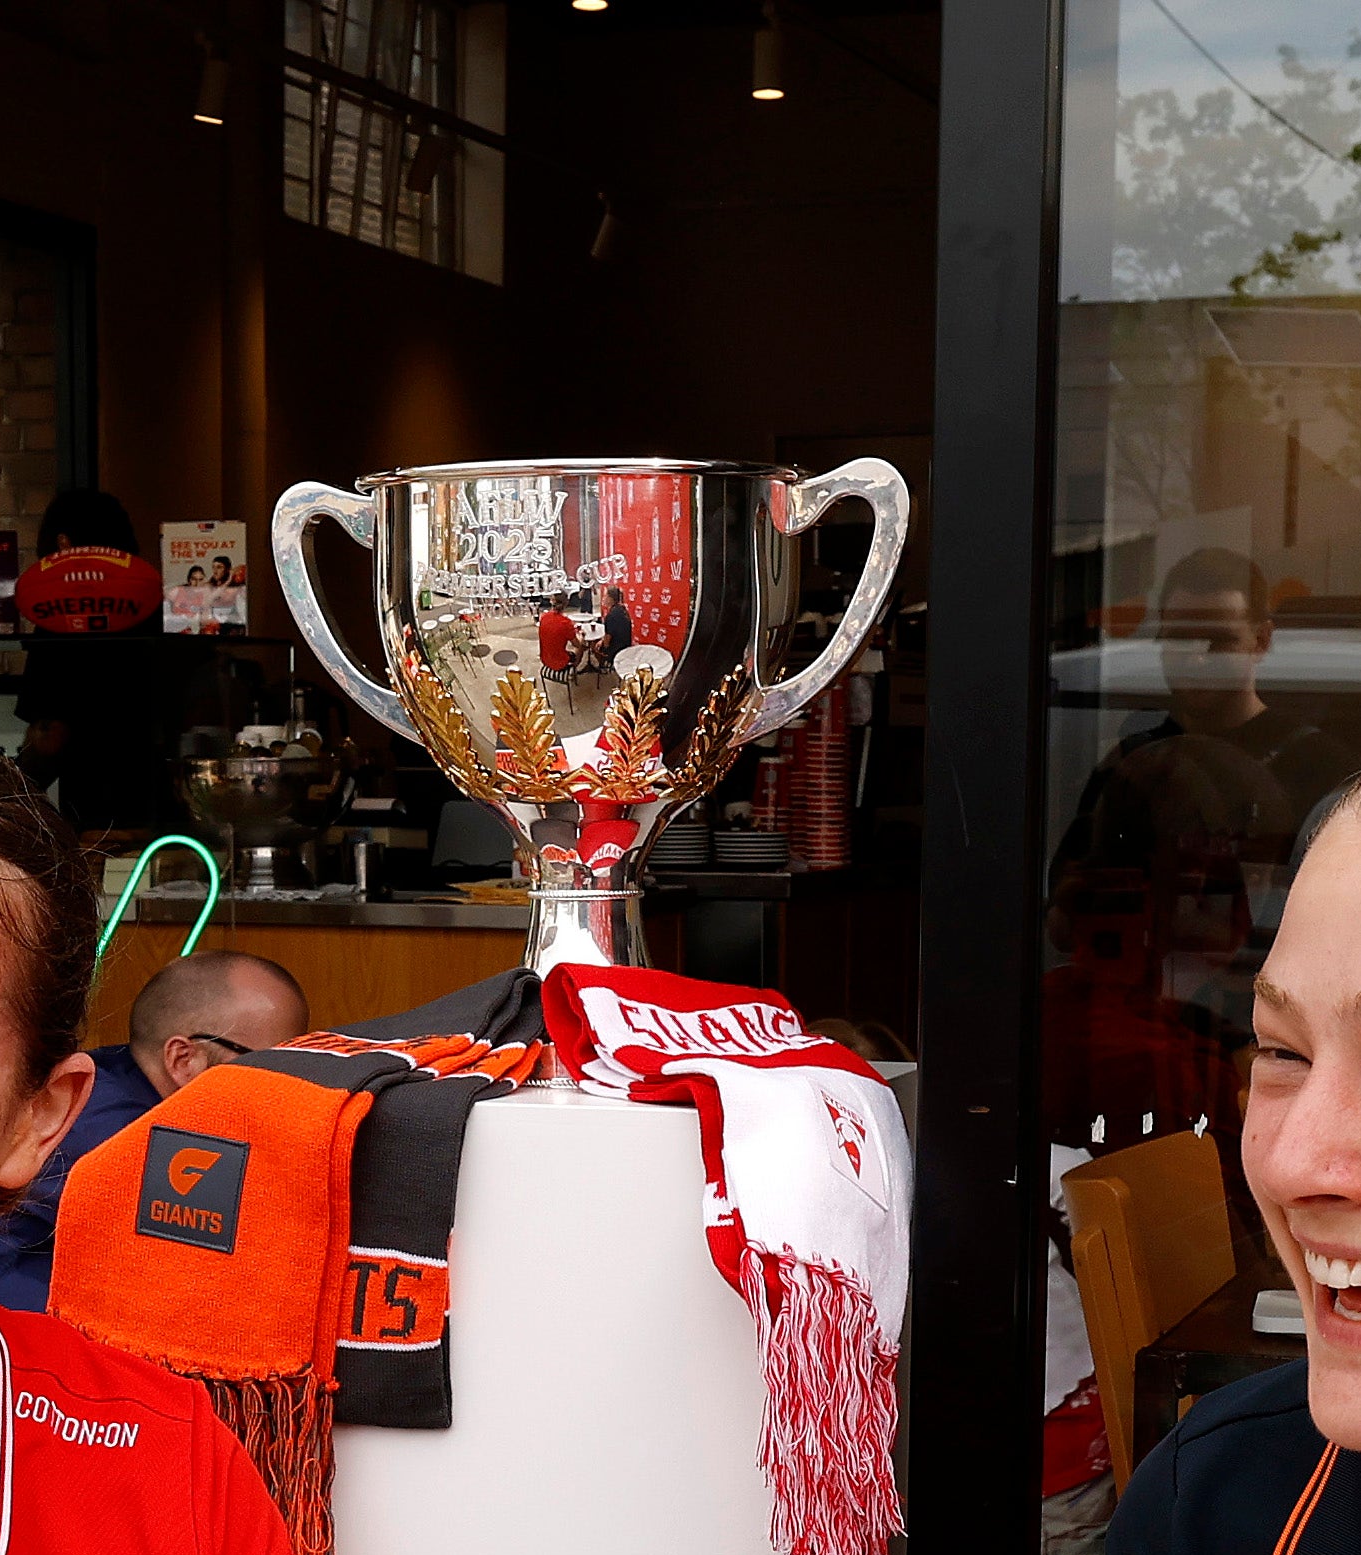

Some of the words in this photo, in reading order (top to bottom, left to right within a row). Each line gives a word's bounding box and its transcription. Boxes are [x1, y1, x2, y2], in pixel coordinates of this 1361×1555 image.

[457, 528, 553, 569] 2025
[576, 553, 627, 588] CUP
[32, 597, 139, 619] SHERRIN
[150, 1200, 224, 1234] GIANTS
